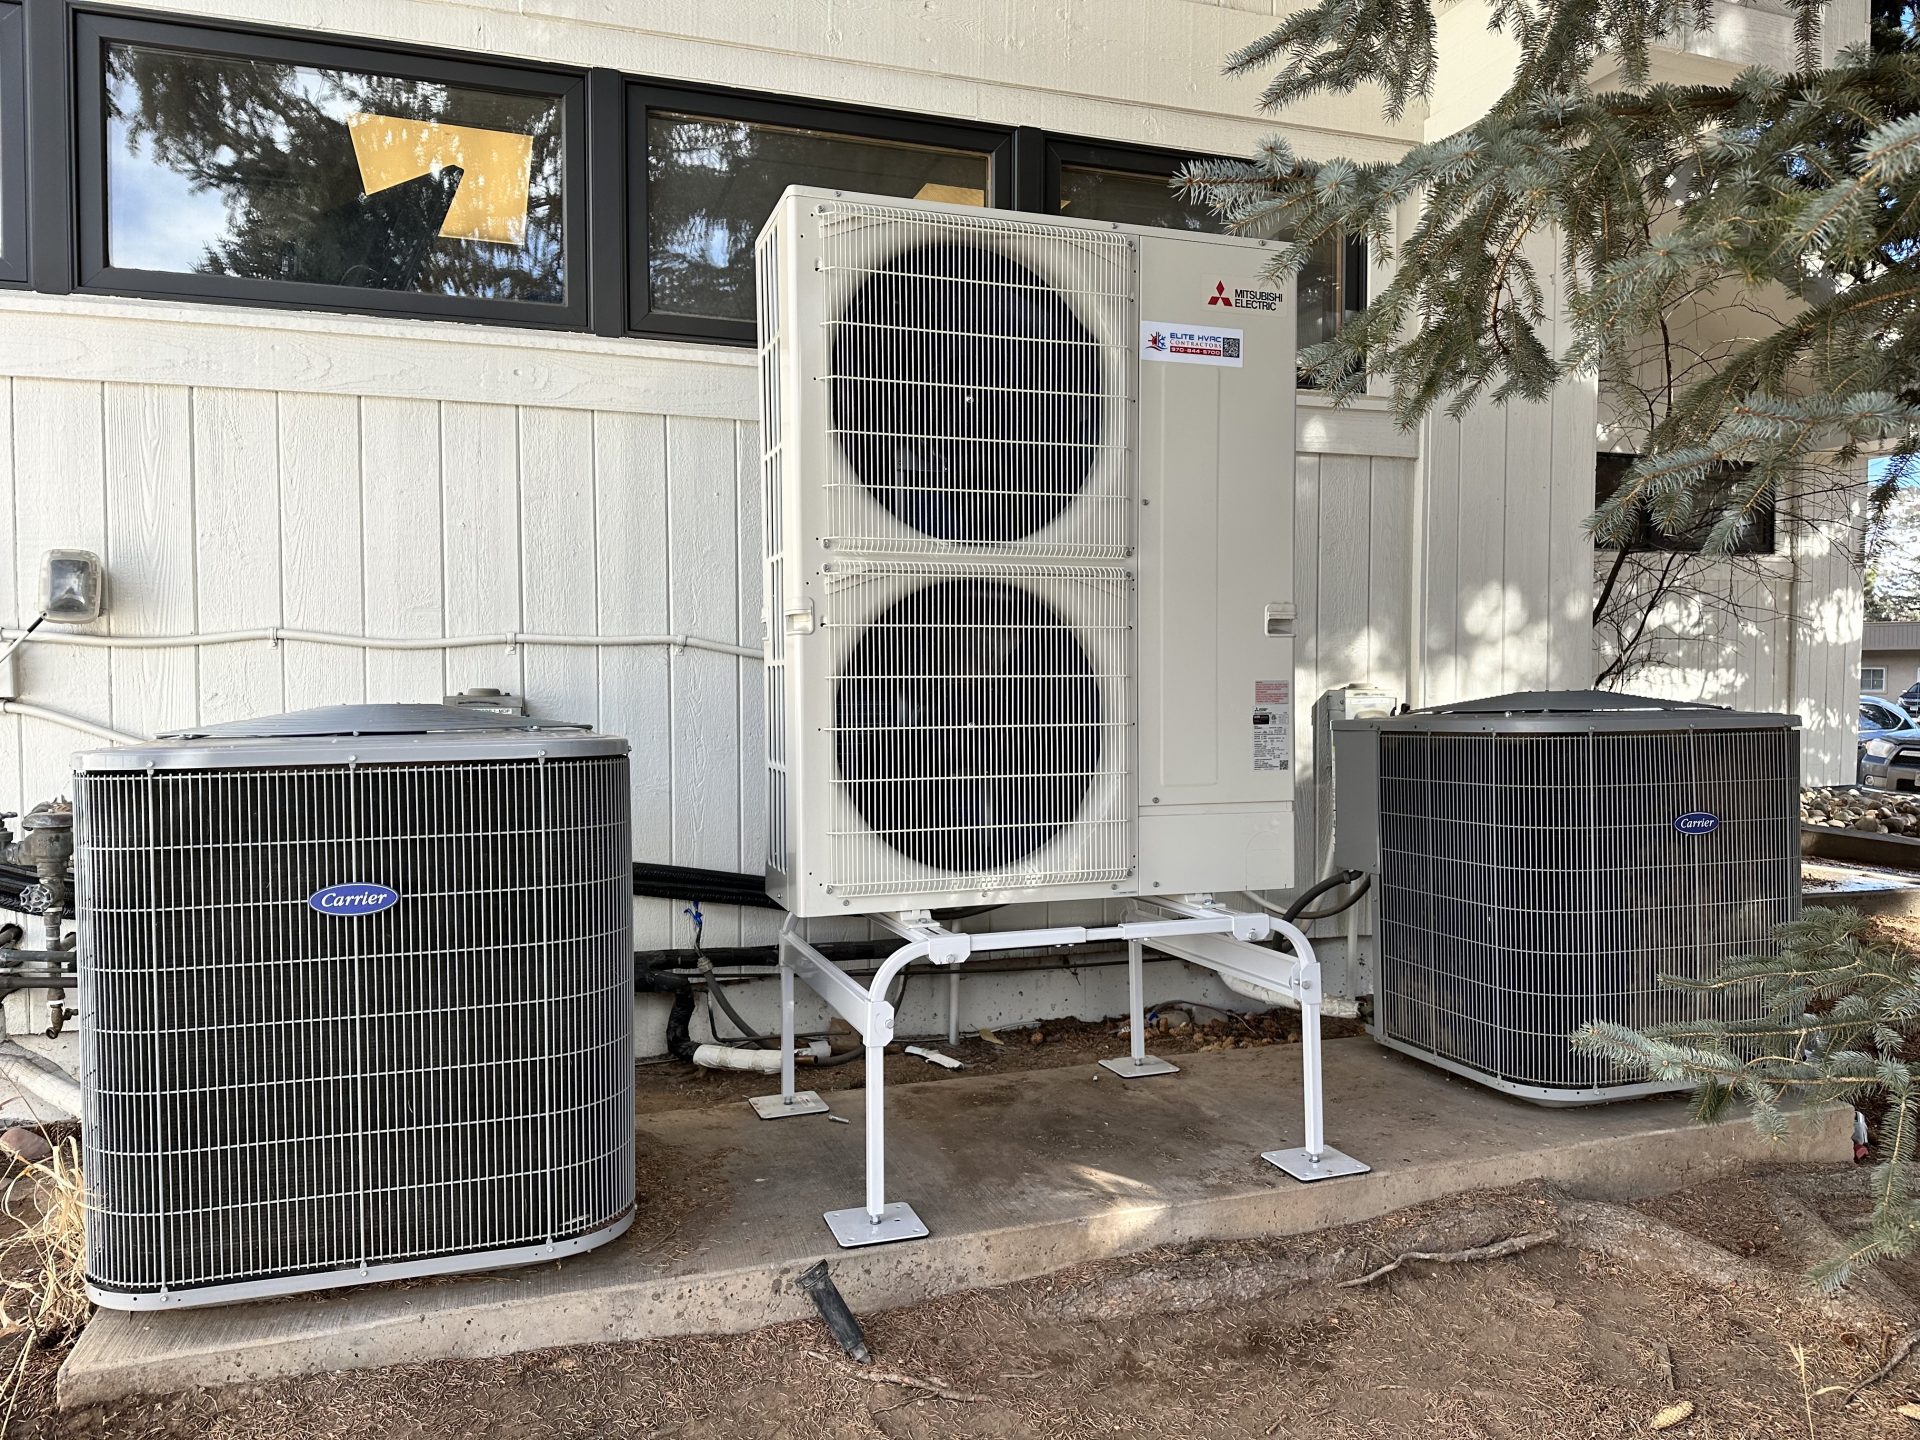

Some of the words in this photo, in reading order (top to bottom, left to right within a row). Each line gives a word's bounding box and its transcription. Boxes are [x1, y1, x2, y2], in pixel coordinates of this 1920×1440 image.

[1235, 289, 1282, 302] MITSUBISHI
[1235, 298, 1276, 311] ELECTRIC
[1170, 333, 1195, 341] ELITE
[1170, 339, 1221, 348] CONTRACTORS
[1681, 818, 1714, 828] Carrier
[321, 891, 388, 907] Carrier
